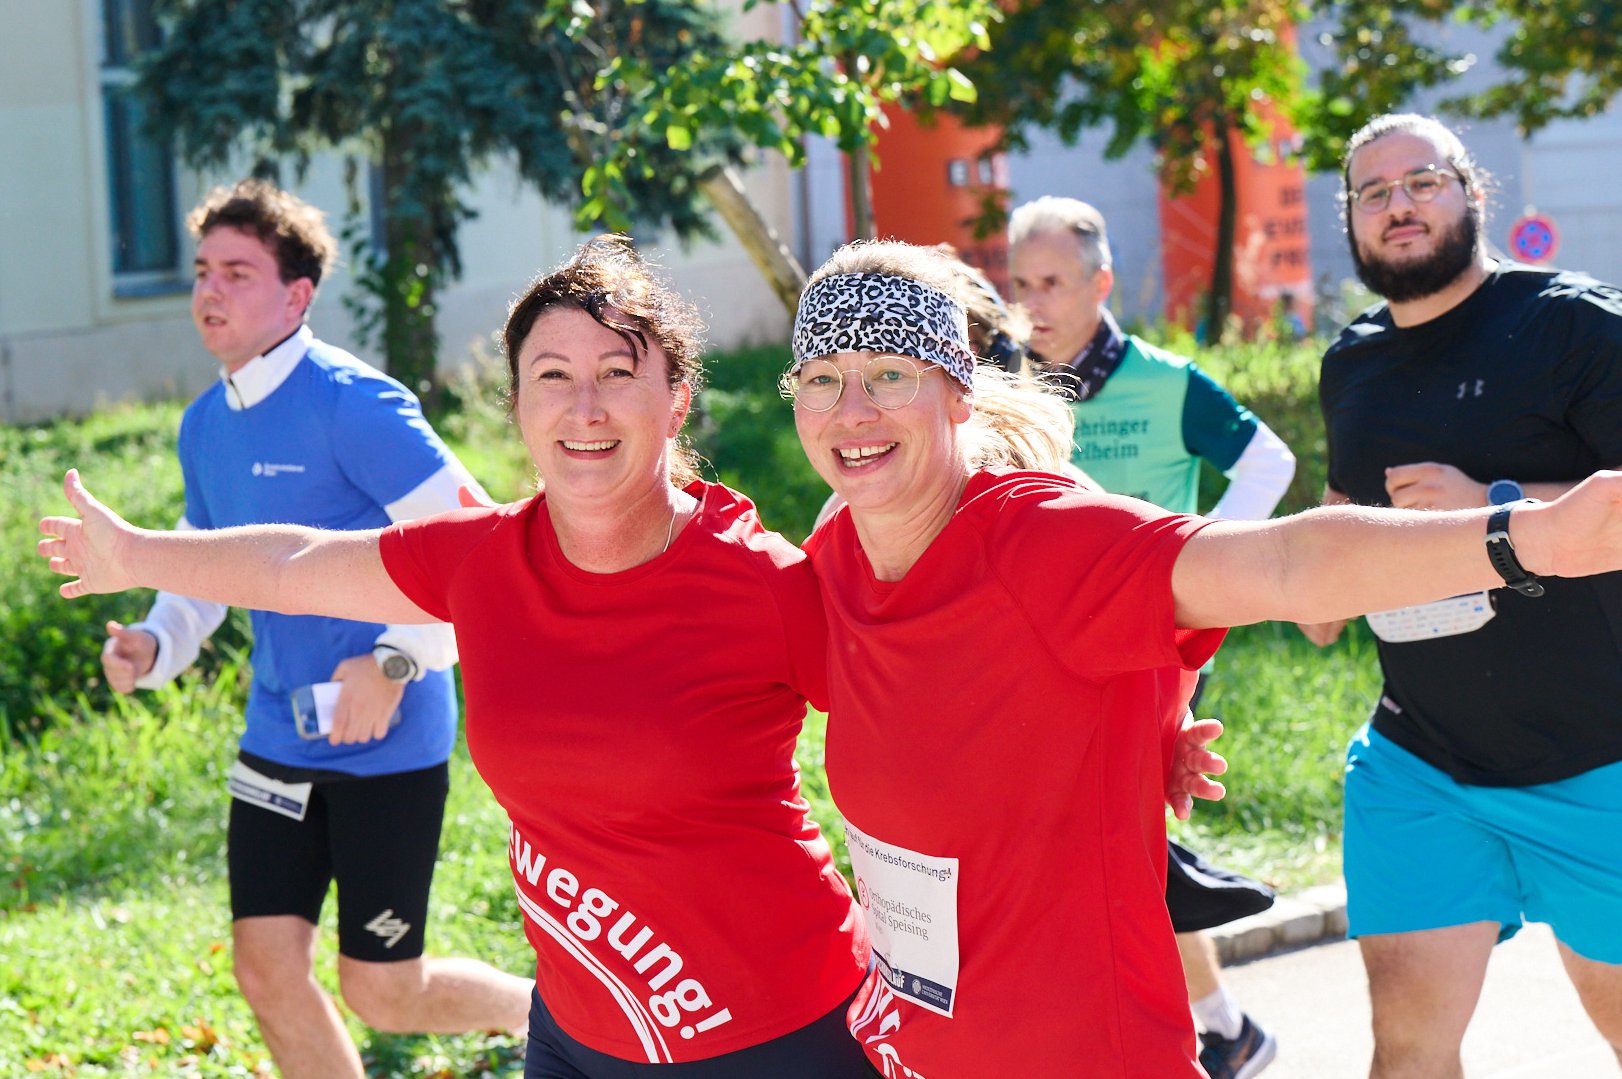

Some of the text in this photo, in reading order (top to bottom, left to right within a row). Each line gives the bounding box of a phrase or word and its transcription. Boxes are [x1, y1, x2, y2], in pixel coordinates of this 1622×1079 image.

[1074, 417, 1150, 438] hringer
[868, 887, 932, 924] Orthopädisches
[509, 820, 733, 1040] wegung!
[888, 915, 929, 941] Speising
